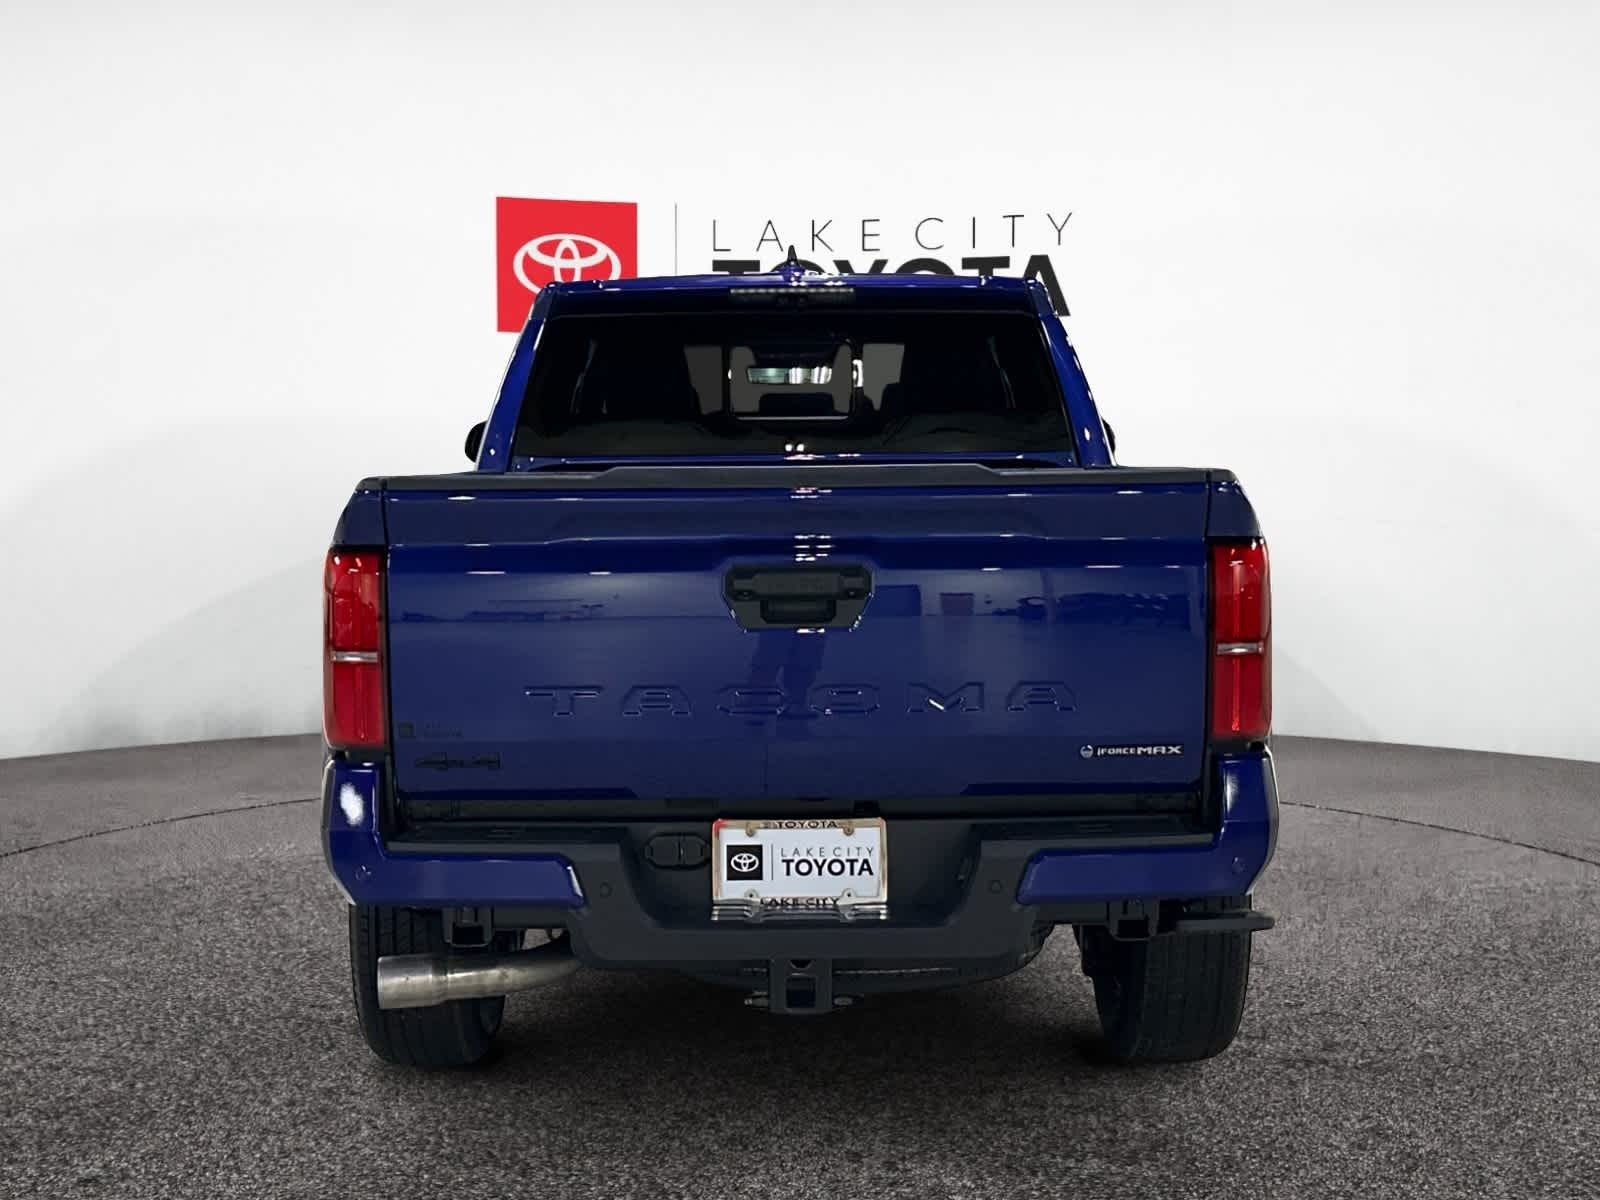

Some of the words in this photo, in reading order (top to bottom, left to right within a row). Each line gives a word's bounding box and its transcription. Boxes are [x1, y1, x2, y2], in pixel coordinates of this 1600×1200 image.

[712, 219, 880, 252] LAKE
[914, 212, 1073, 250] CITY
[524, 681, 1078, 717] TACOMA
[777, 820, 838, 829] TOYOTA
[780, 848, 825, 857] LAKE
[833, 847, 875, 857] CITY
[781, 858, 874, 876] TOYOTA
[760, 898, 801, 907] LAKE
[806, 897, 840, 906] CITY
